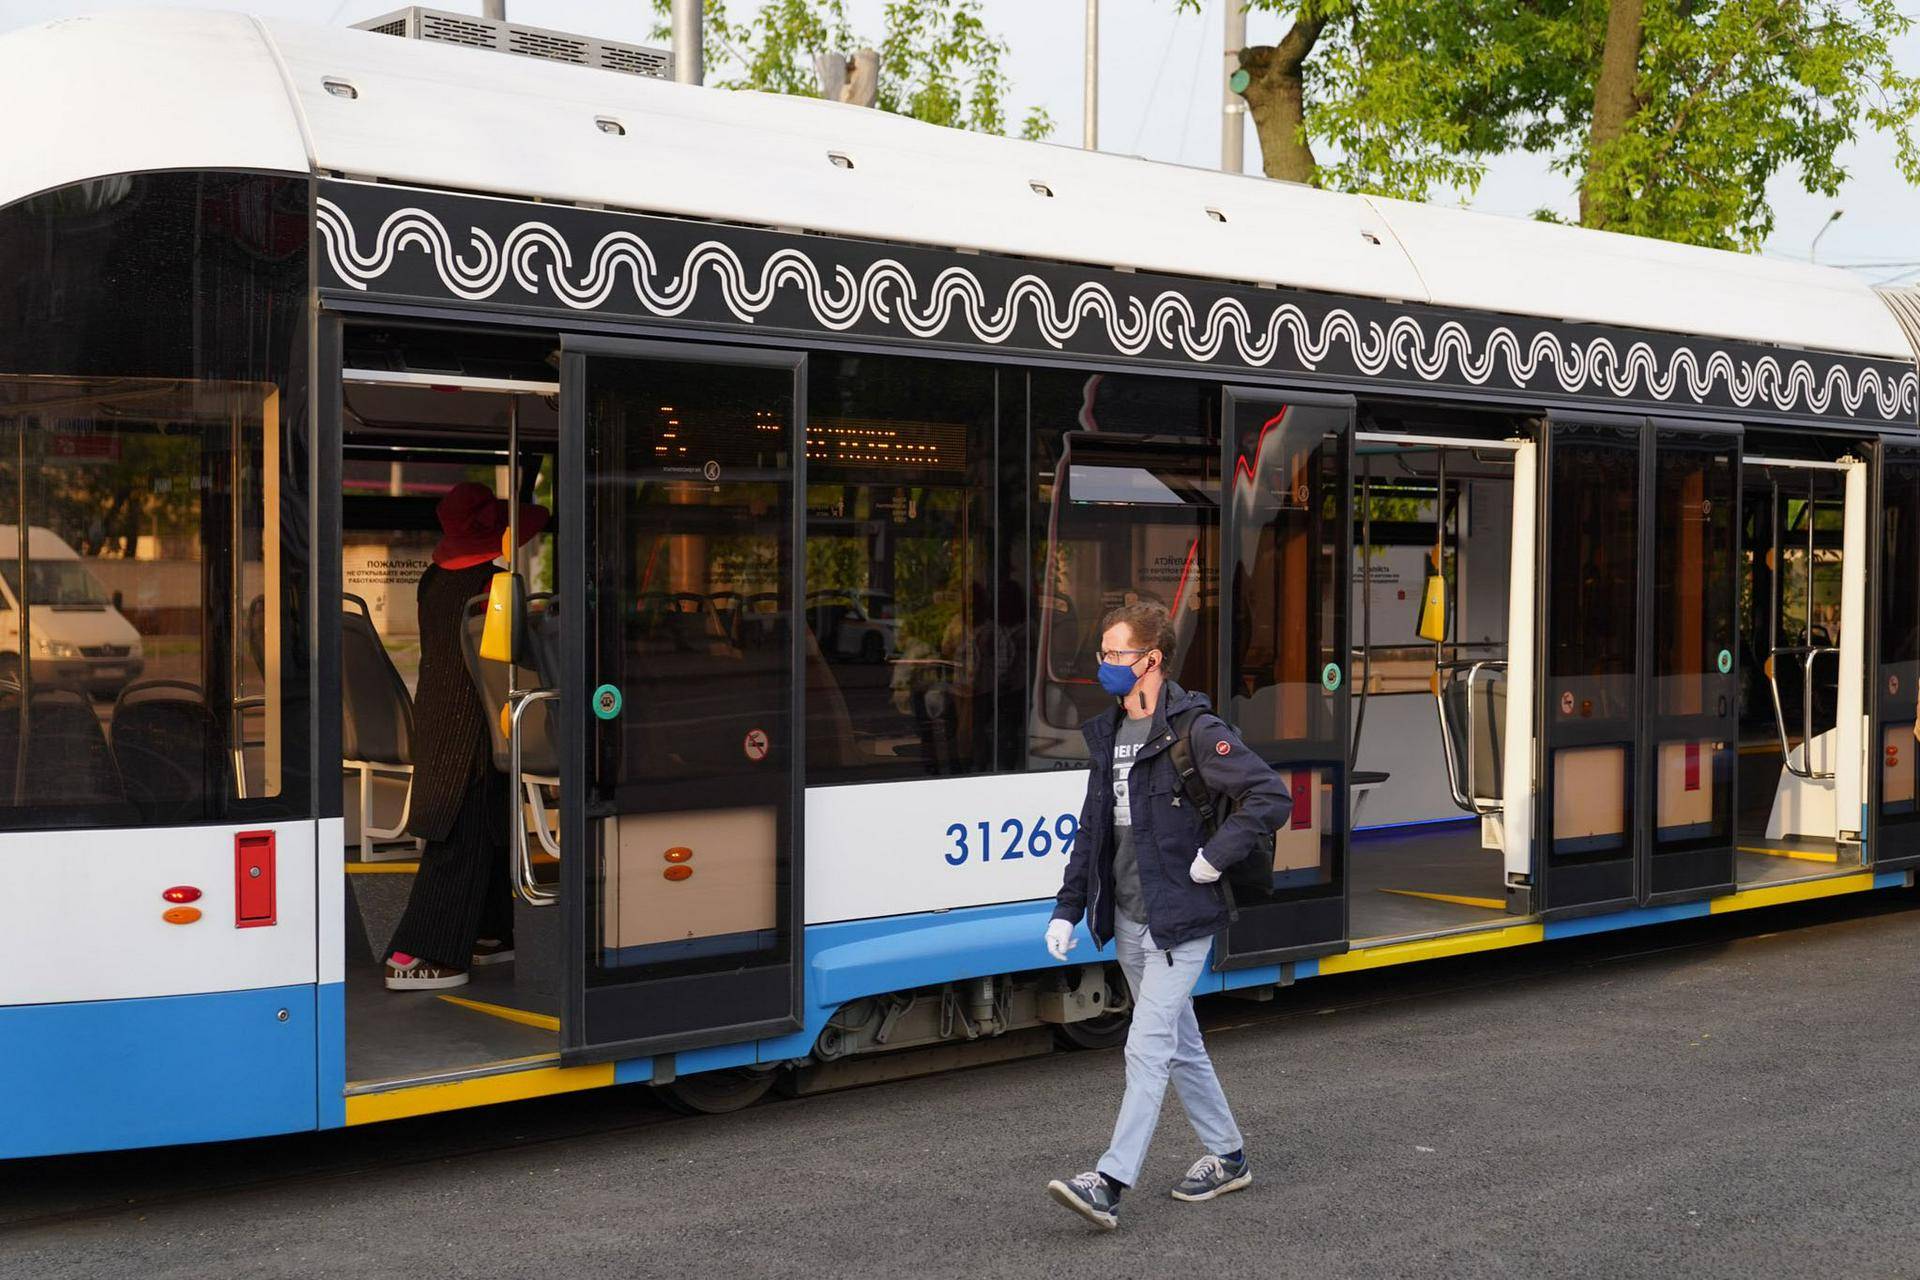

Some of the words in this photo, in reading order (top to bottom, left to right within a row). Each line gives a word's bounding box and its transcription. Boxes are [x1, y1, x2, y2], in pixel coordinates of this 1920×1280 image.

[367, 559, 428, 569] ПОЖАЛУЙСТА
[944, 813, 1079, 866] 31269
[394, 968, 440, 979] DKNY
